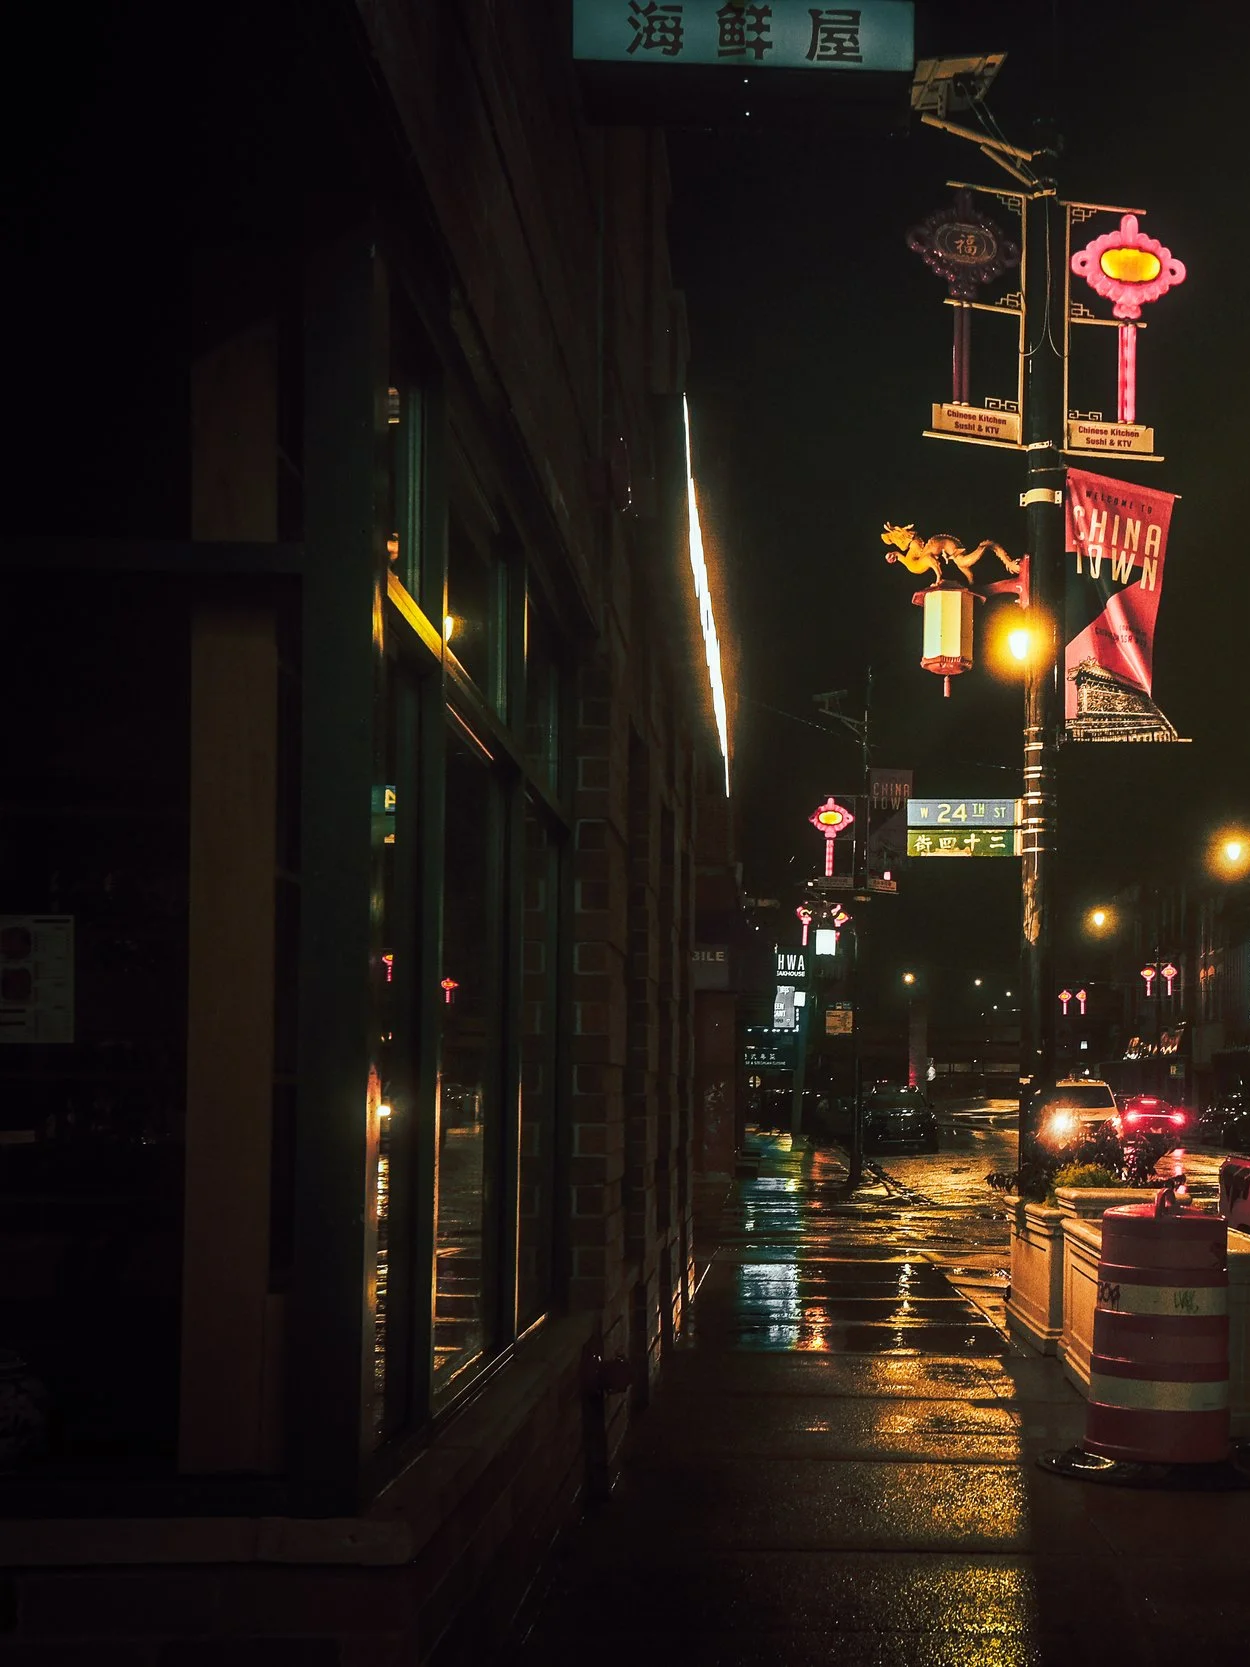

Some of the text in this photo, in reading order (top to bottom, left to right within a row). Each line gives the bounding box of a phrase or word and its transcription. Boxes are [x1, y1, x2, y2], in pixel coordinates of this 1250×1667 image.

[625, 0, 863, 63] 海鮮屋
[946, 409, 1007, 425] Chinese Kitchen
[954, 421, 999, 435] Sushi & KTV
[1078, 426, 1140, 438] Chinese Kitchen
[1085, 437, 1132, 448] Sushi & KTV
[1086, 490, 1153, 514] WELCOME TO
[1073, 505, 1162, 557] CHINA
[1072, 540, 1158, 591] TOWN
[873, 782, 910, 797] CHINA
[920, 807, 929, 819] W
[993, 807, 1007, 818] ST
[777, 953, 805, 971] HWA
